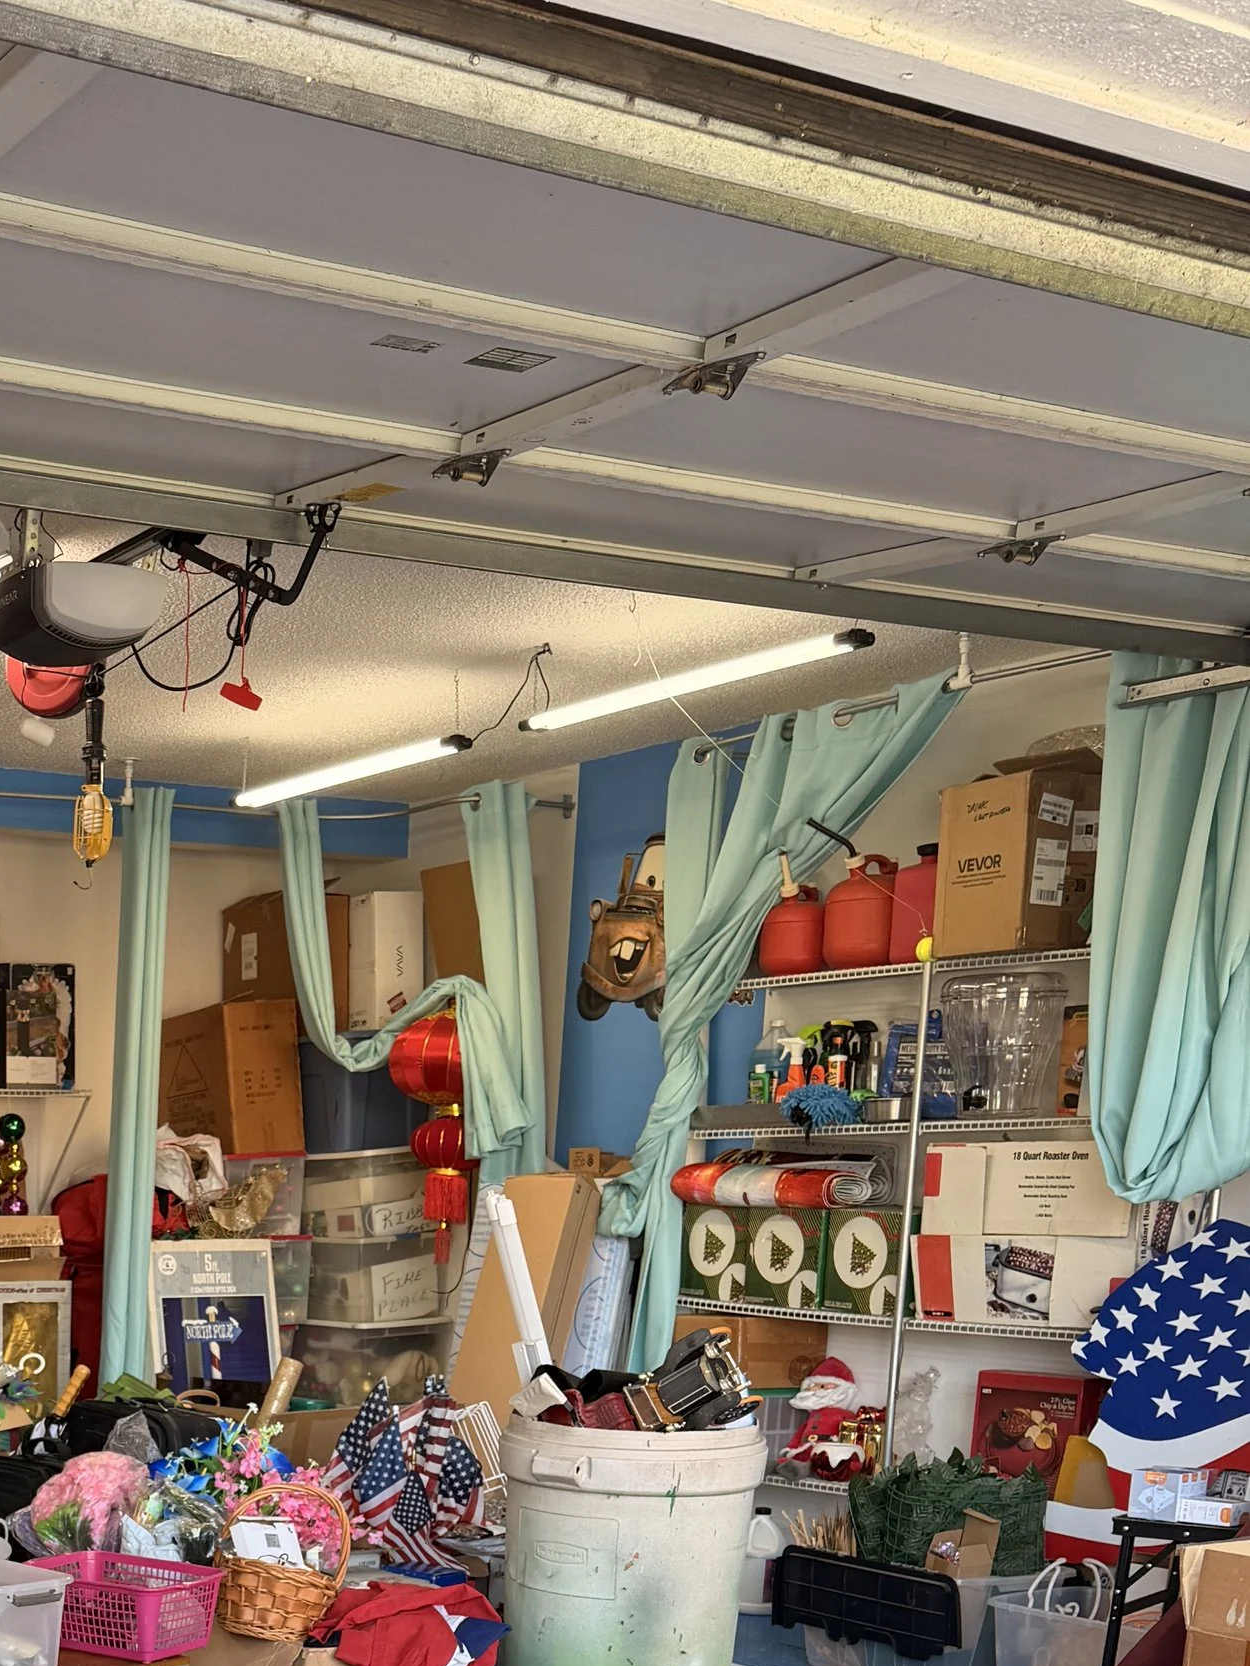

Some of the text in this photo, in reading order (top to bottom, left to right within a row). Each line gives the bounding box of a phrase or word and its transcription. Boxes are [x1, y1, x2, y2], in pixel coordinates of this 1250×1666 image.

[957, 854, 1002, 873] VEVOR
[1022, 1150, 1042, 1162] Quart
[1042, 1150, 1071, 1161] Roaster
[1071, 1150, 1090, 1161] Oven
[375, 1204, 424, 1231] RIBB
[192, 1272, 232, 1285] NORTH POLE
[381, 1267, 428, 1296] FIRE
[378, 1287, 430, 1319] PLACE
[186, 1323, 235, 1340] NORTH POLE
